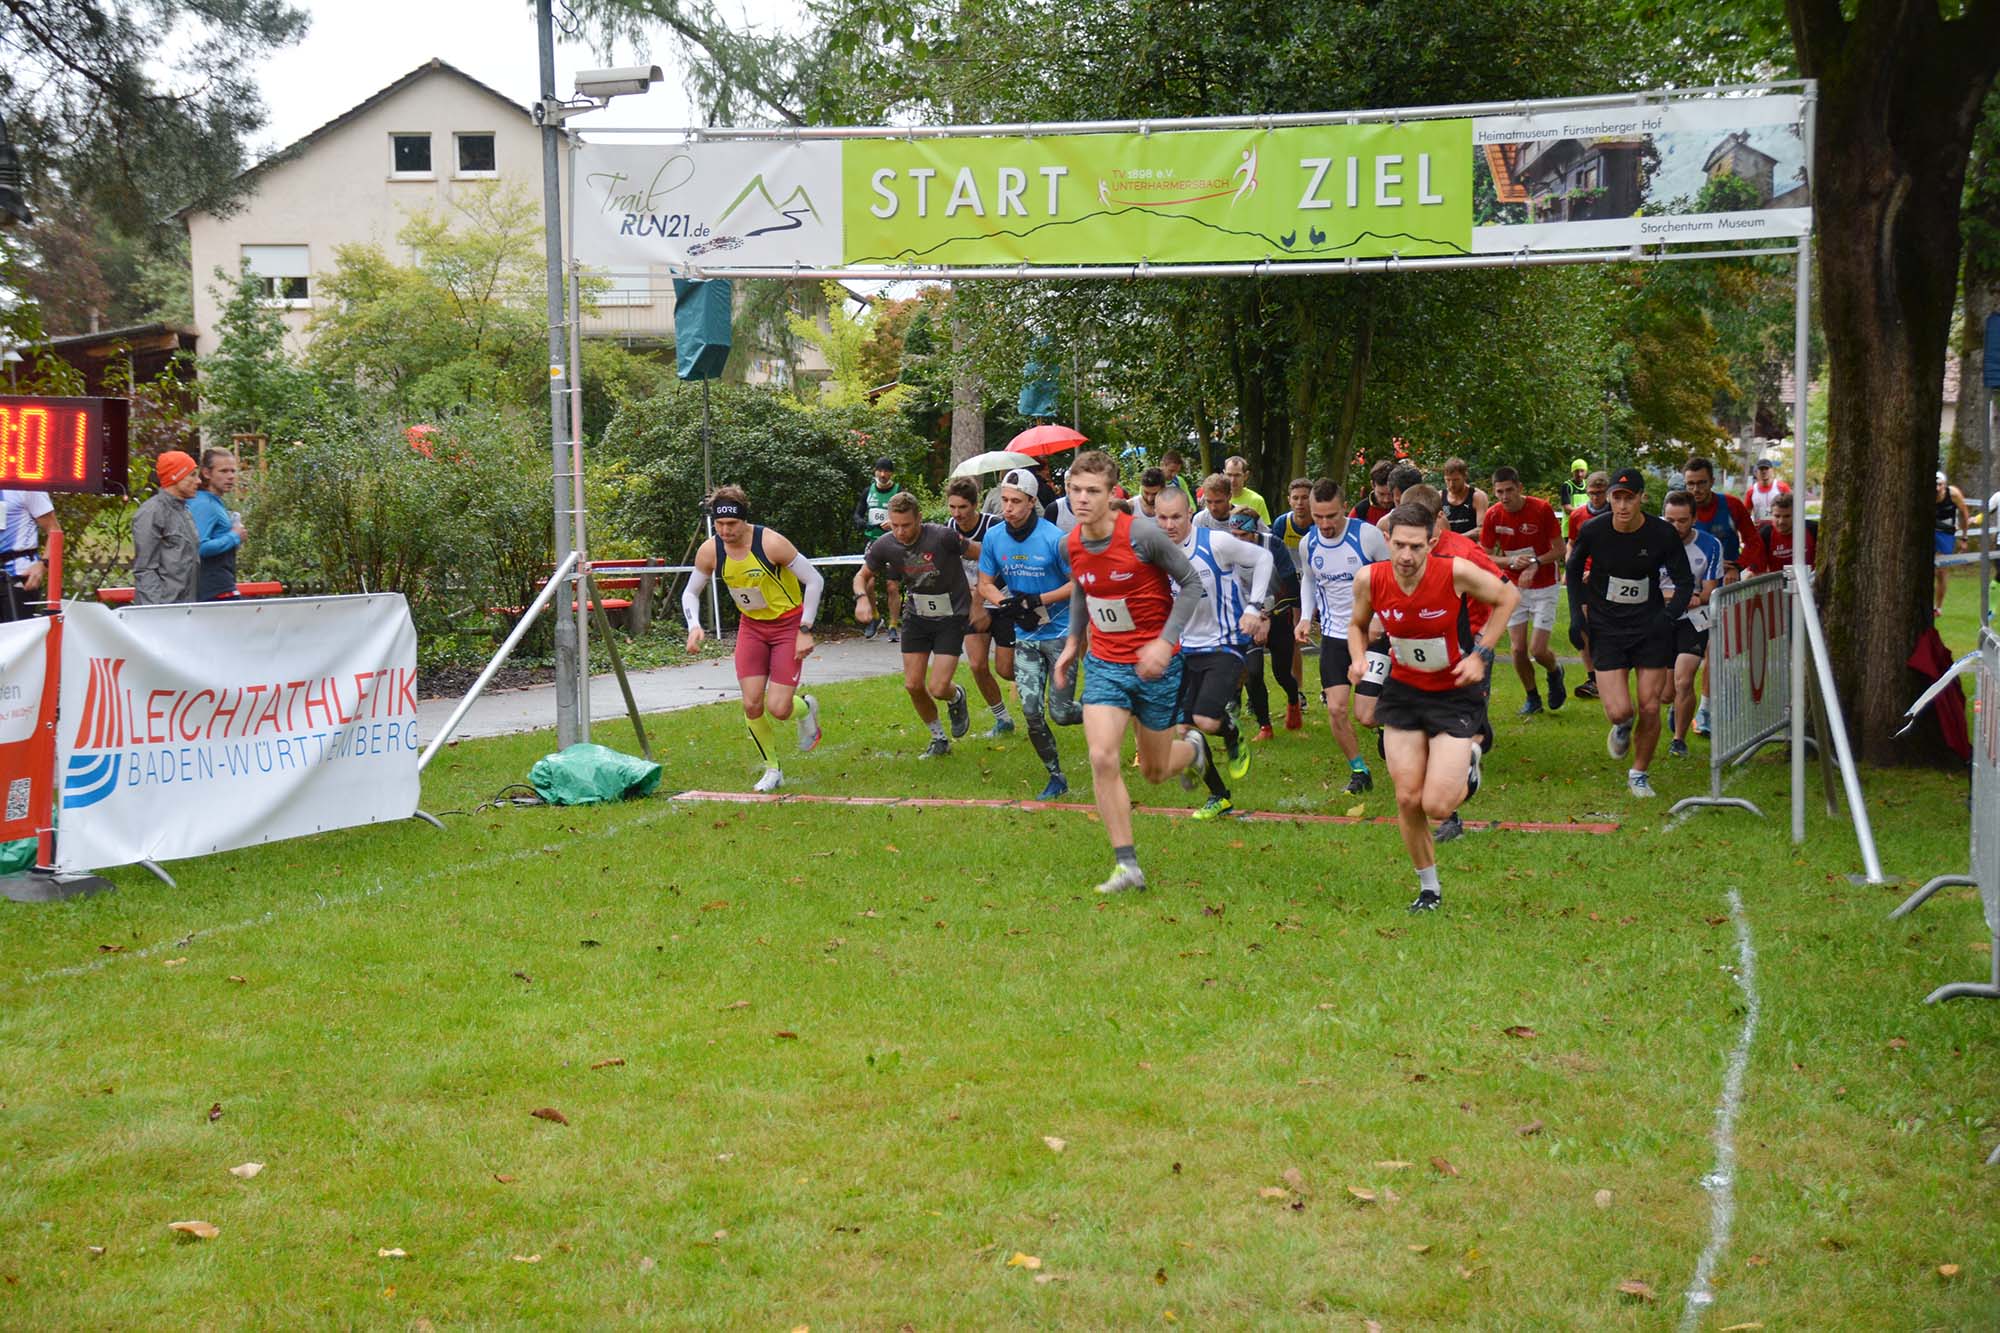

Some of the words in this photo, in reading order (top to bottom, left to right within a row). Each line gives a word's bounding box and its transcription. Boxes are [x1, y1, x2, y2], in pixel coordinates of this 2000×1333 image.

[1478, 128, 1558, 142] Heimatmuseum
[1642, 118, 1662, 130] Hof
[586, 154, 695, 214] Trail
[1112, 179, 1230, 192] UNTERHARMERSBACH
[1298, 153, 1443, 209] ZIEL
[870, 165, 1068, 219] START
[1641, 221, 1713, 234] Storchenturm
[1718, 217, 1765, 229] Museum
[716, 506, 737, 514] GORE
[874, 512, 885, 521] 66
[740, 593, 751, 604] 3
[1620, 586, 1639, 597] 26
[928, 601, 936, 611] 5
[1098, 608, 1117, 623] 10
[1414, 648, 1426, 663] 8
[1369, 660, 1385, 675] 12
[127, 667, 417, 744] LEICHTATHLETIK
[128, 720, 418, 786] BADEN-WÜRTTEMBERG
